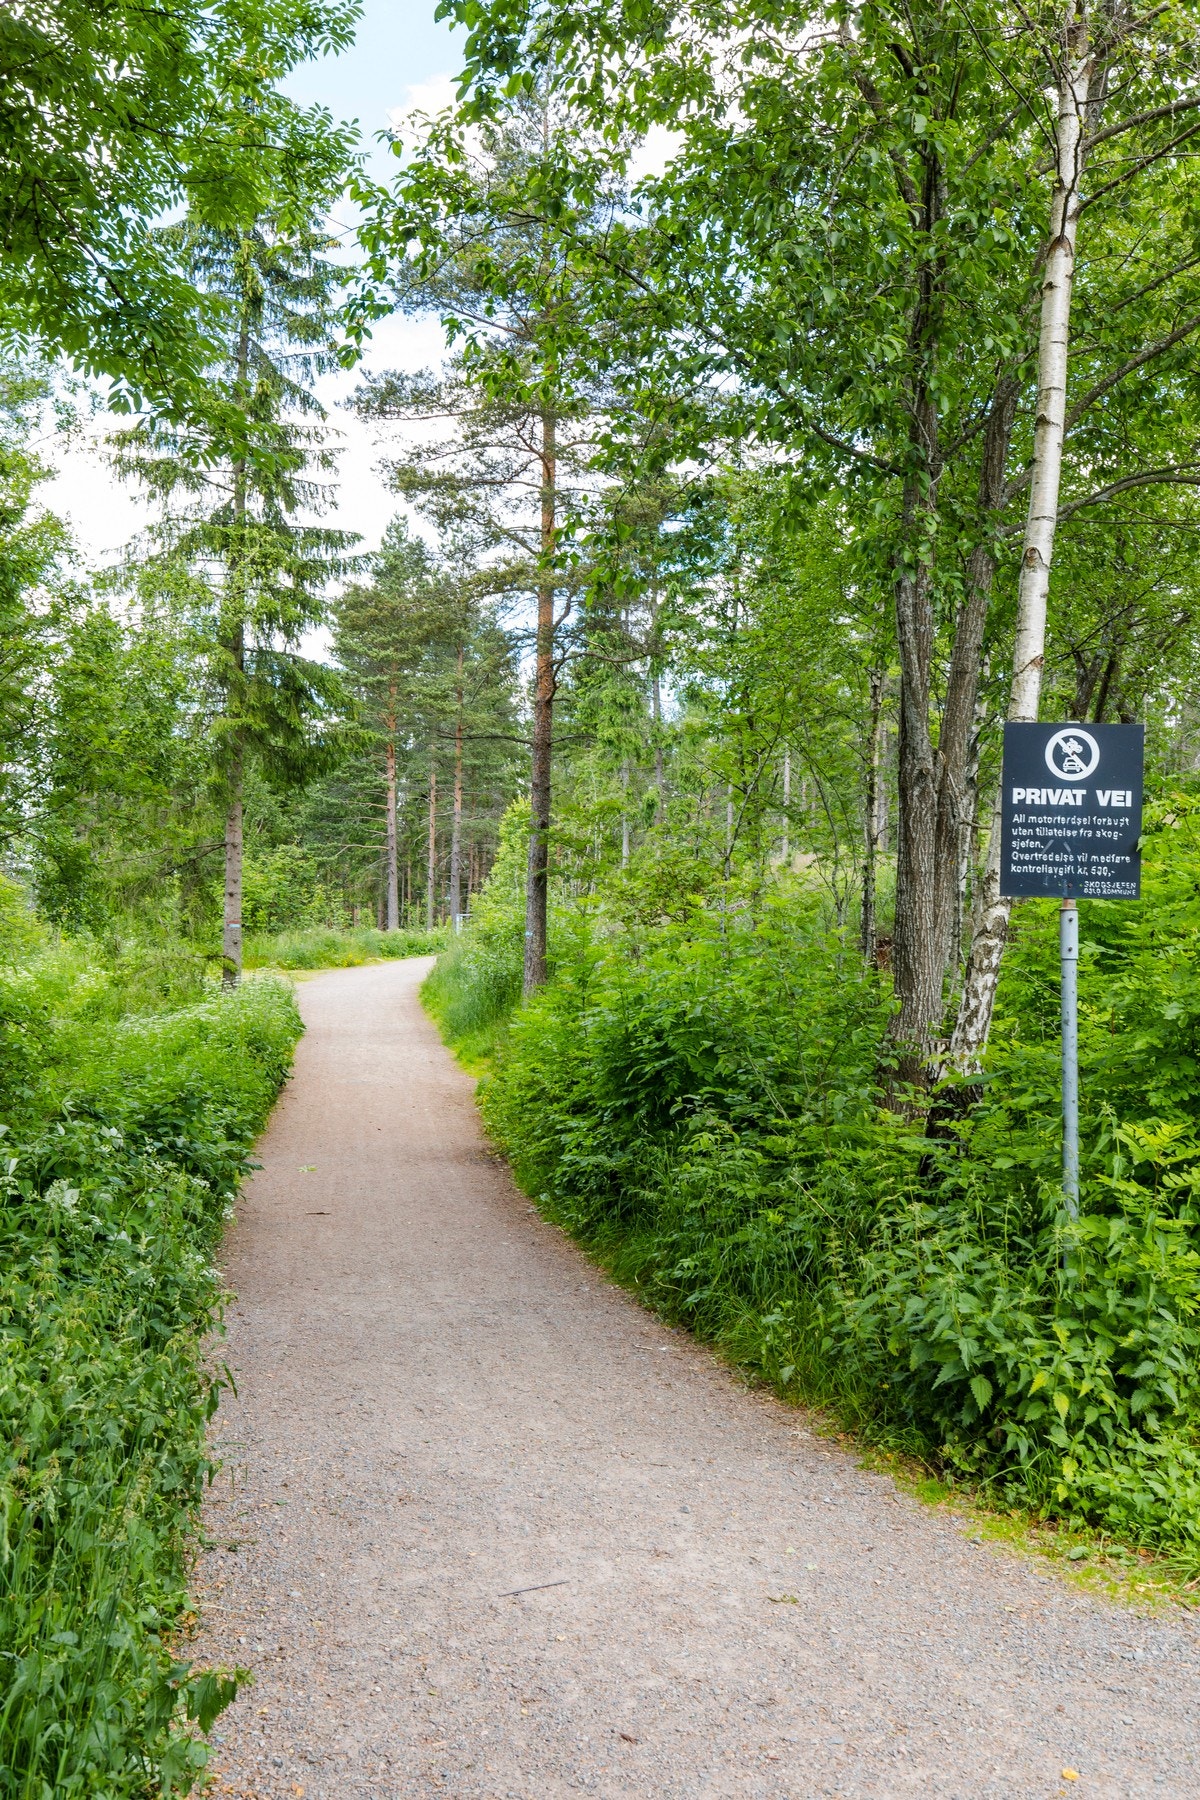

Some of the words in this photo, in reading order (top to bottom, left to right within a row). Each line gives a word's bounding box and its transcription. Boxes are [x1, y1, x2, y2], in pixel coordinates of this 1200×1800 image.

[1012, 787, 1087, 806] PRIVAT
[1095, 789, 1132, 807] VEI
[1012, 814, 1026, 824] All
[1011, 827, 1034, 836] uten
[1035, 827, 1078, 837] tillatelse
[1079, 828, 1093, 837] fra
[1095, 829, 1123, 840] skog-
[1011, 839, 1045, 850] sjefen.
[1011, 851, 1075, 862] Overtredelse
[1076, 852, 1088, 862] vil
[1010, 863, 1075, 876] kontrollavgift
